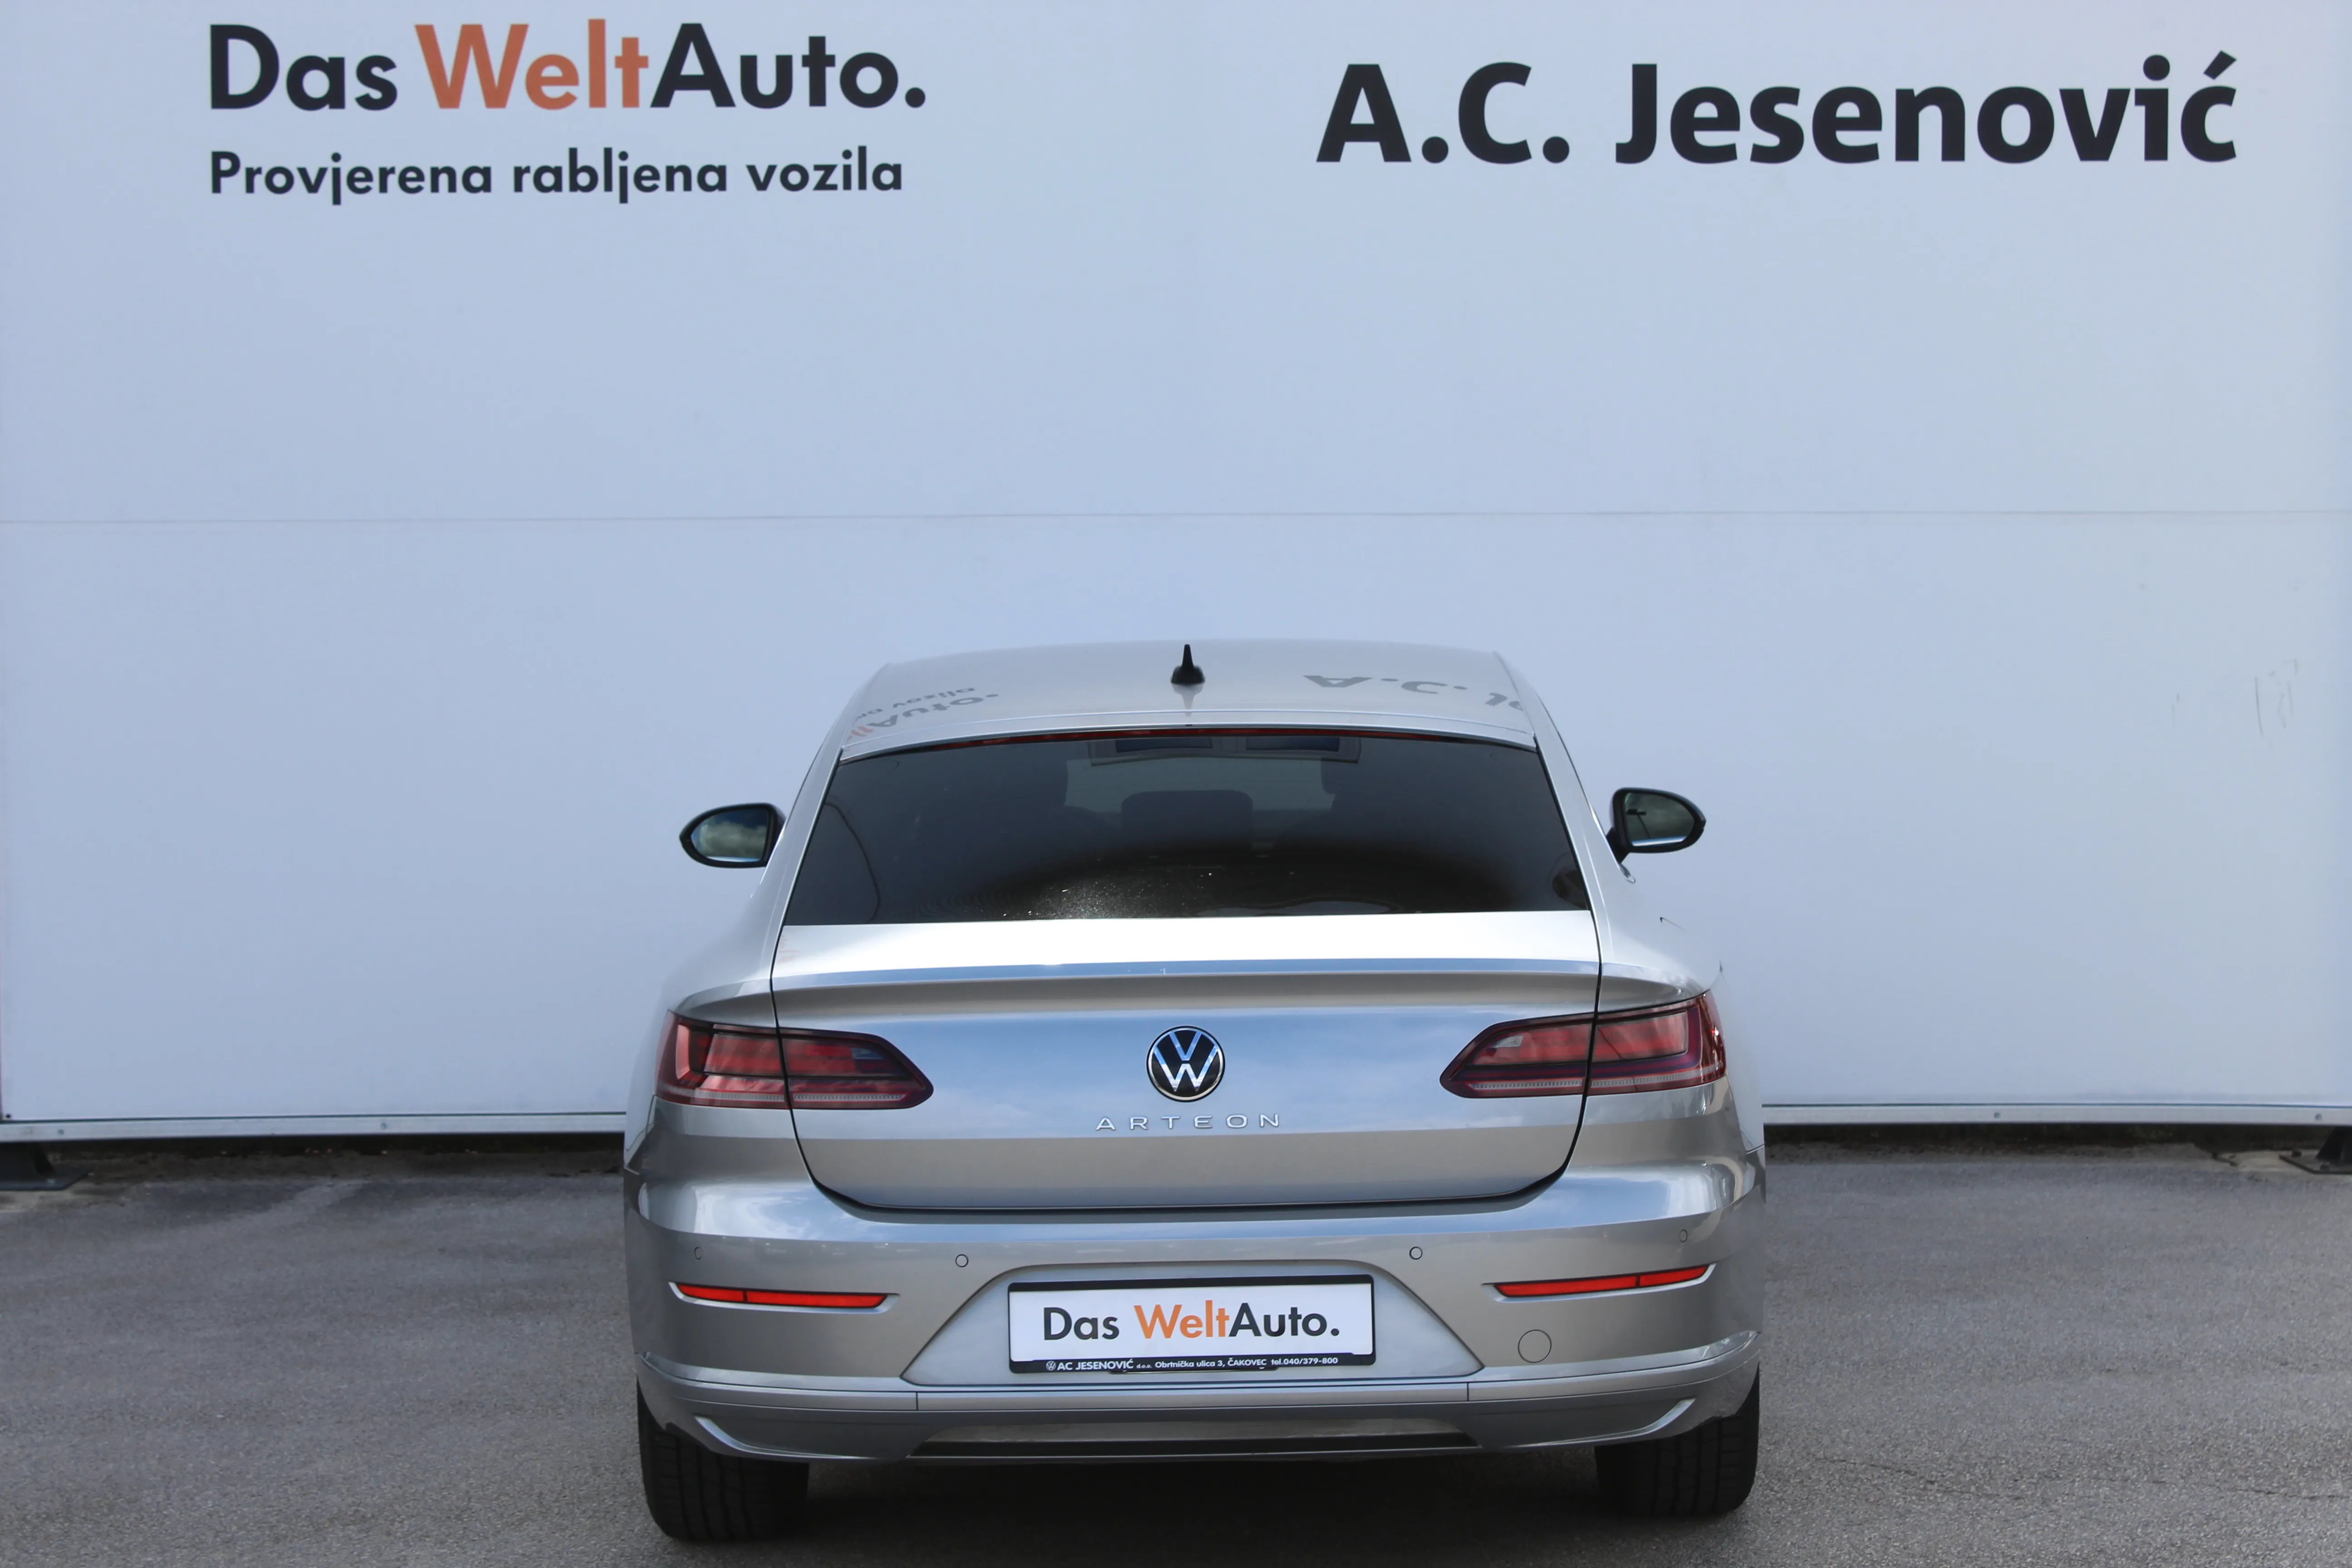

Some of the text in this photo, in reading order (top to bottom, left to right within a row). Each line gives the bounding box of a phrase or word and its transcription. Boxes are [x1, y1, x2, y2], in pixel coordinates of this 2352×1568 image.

[210, 19, 926, 111] Das WeltAuto.
[1317, 50, 2237, 164] A.C. Jesenović
[211, 145, 902, 206] Provjerena rabljena vozila
[1095, 1114, 1279, 1131] ARTEON
[1044, 1300, 1340, 1341] Das WeltAuto.
[1057, 1362, 1073, 1370] AC
[1075, 1358, 1134, 1370] JESENOVIĆ
[1155, 1360, 1195, 1368] Obrtnička
[1228, 1357, 1267, 1367] ČAKOVEC
[1271, 1357, 1338, 1365] tel.040/379-800
